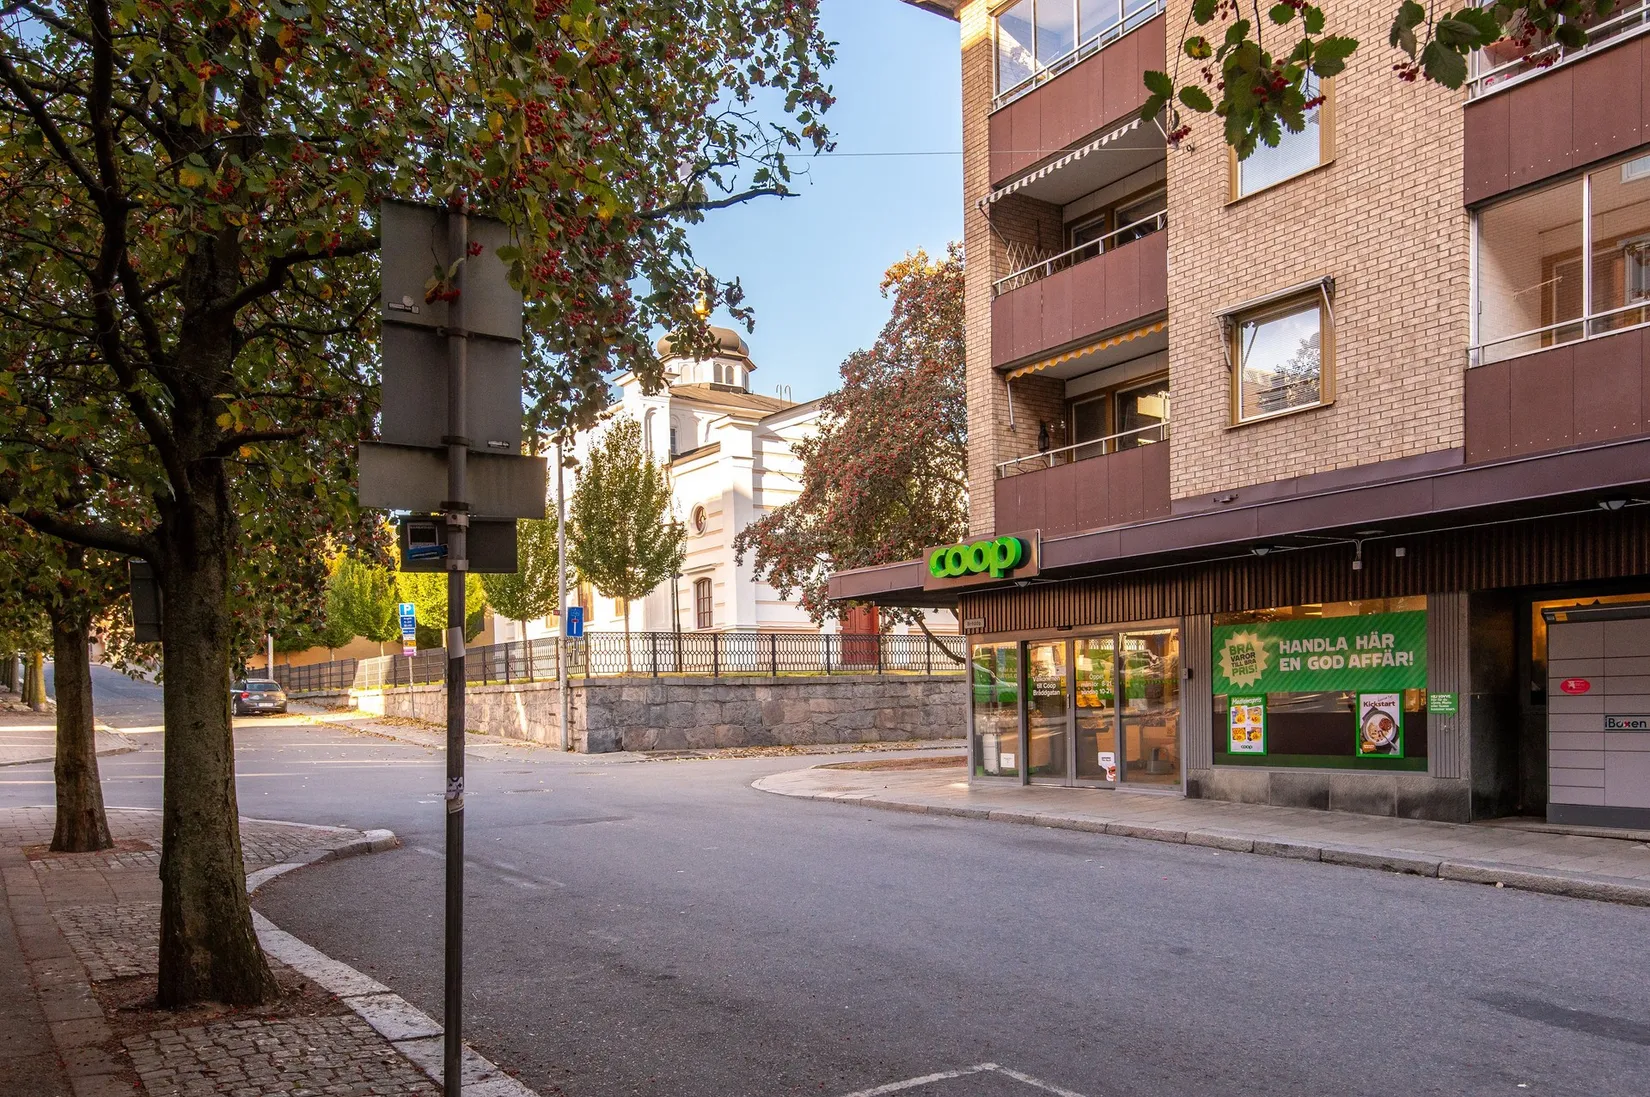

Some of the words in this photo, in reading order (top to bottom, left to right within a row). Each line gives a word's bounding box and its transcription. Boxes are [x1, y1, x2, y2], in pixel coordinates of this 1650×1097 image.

[929, 536, 1020, 578] coop
[1229, 642, 1255, 655] BRA
[1280, 636, 1348, 654] HANDLA
[1356, 631, 1394, 650] HÄR
[1230, 651, 1256, 662] VAROR
[1280, 657, 1301, 671] EN
[1307, 655, 1344, 670] GOD
[1348, 649, 1413, 668] AFFÄR!
[1232, 665, 1258, 677] PRIS!
